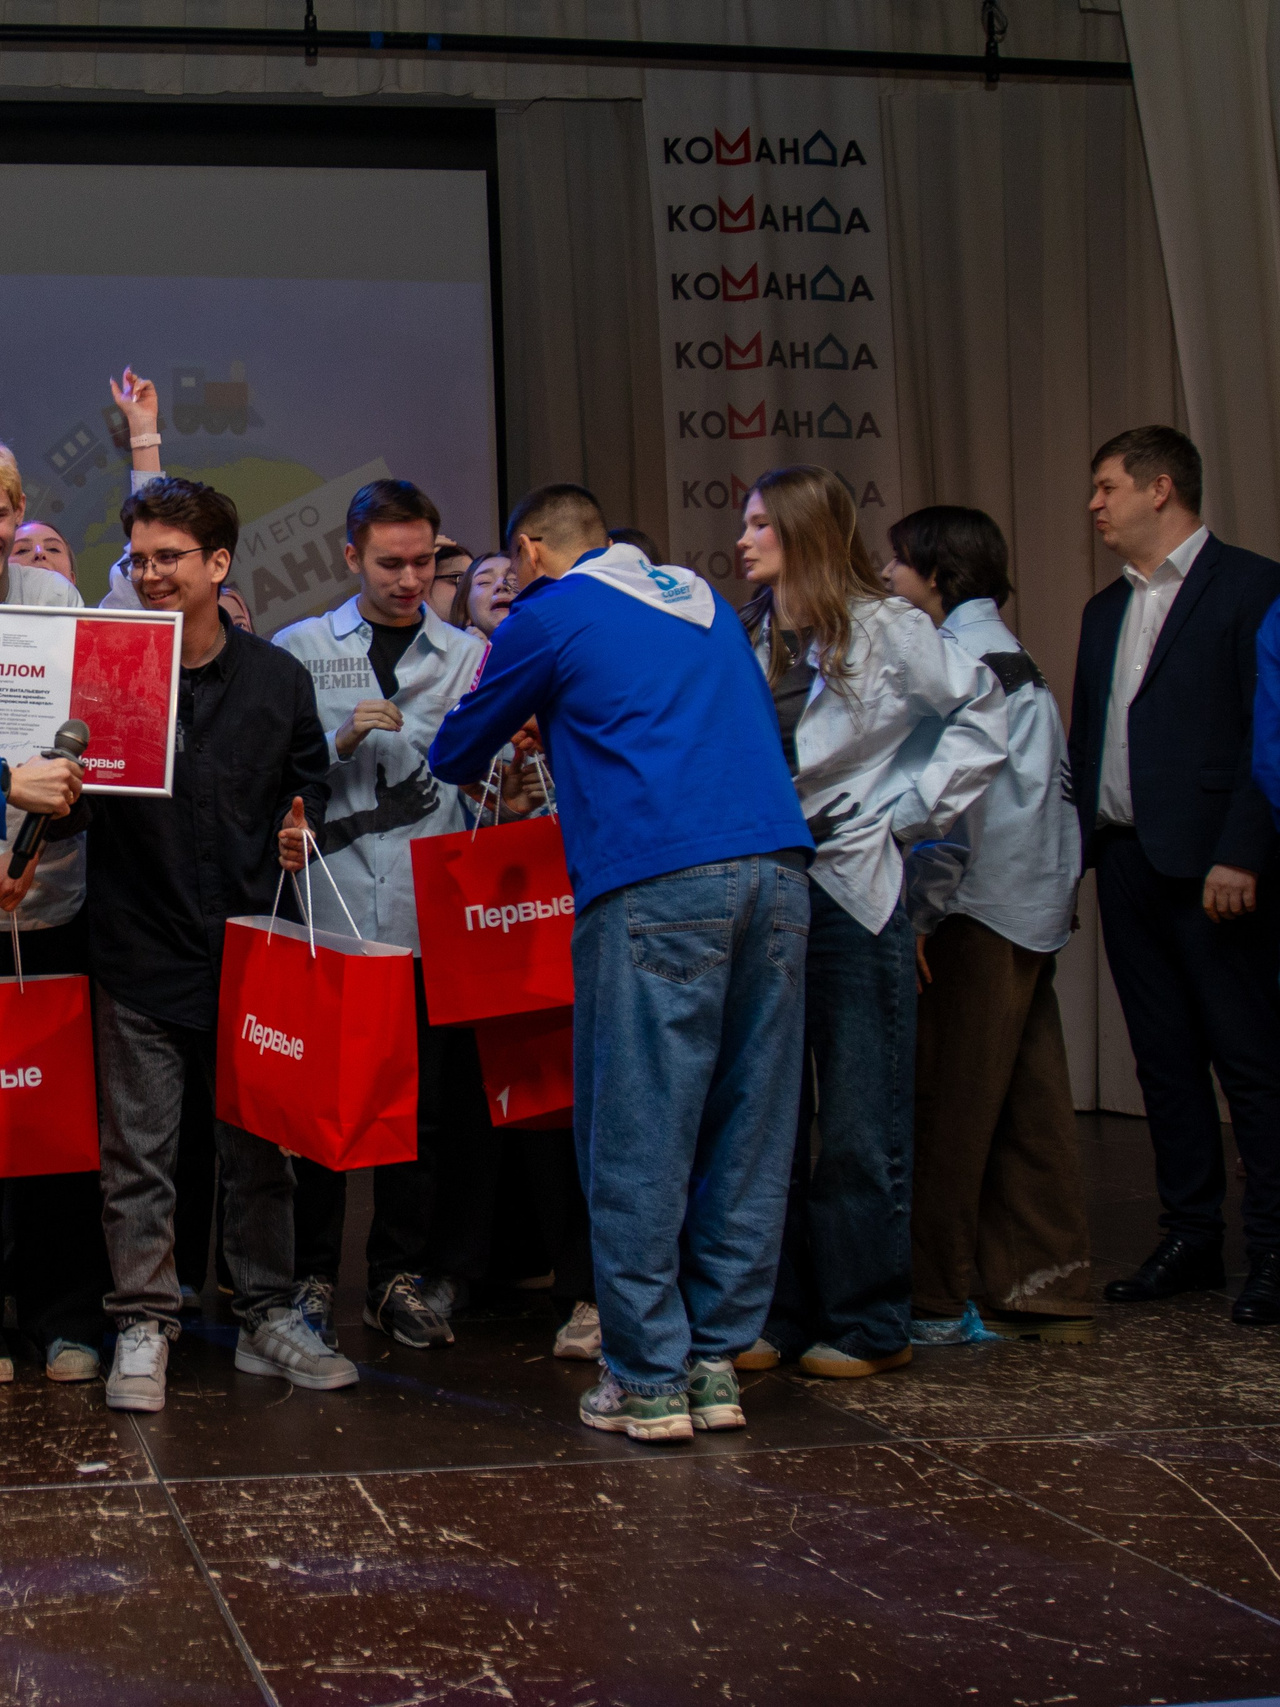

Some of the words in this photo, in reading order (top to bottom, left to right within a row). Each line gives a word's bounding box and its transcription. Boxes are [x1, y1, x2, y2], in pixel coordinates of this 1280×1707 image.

[663, 126, 867, 166] КОМАНДА
[667, 194, 871, 234] КОМАНДА
[671, 262, 874, 302] КОМАНДА
[675, 330, 878, 371] КОМАНДА
[679, 399, 881, 440] КОМАНДА
[270, 505, 320, 544] ЕГО
[78, 756, 126, 771] ервые
[465, 894, 575, 933] Первые
[241, 1013, 305, 1061] Первые
